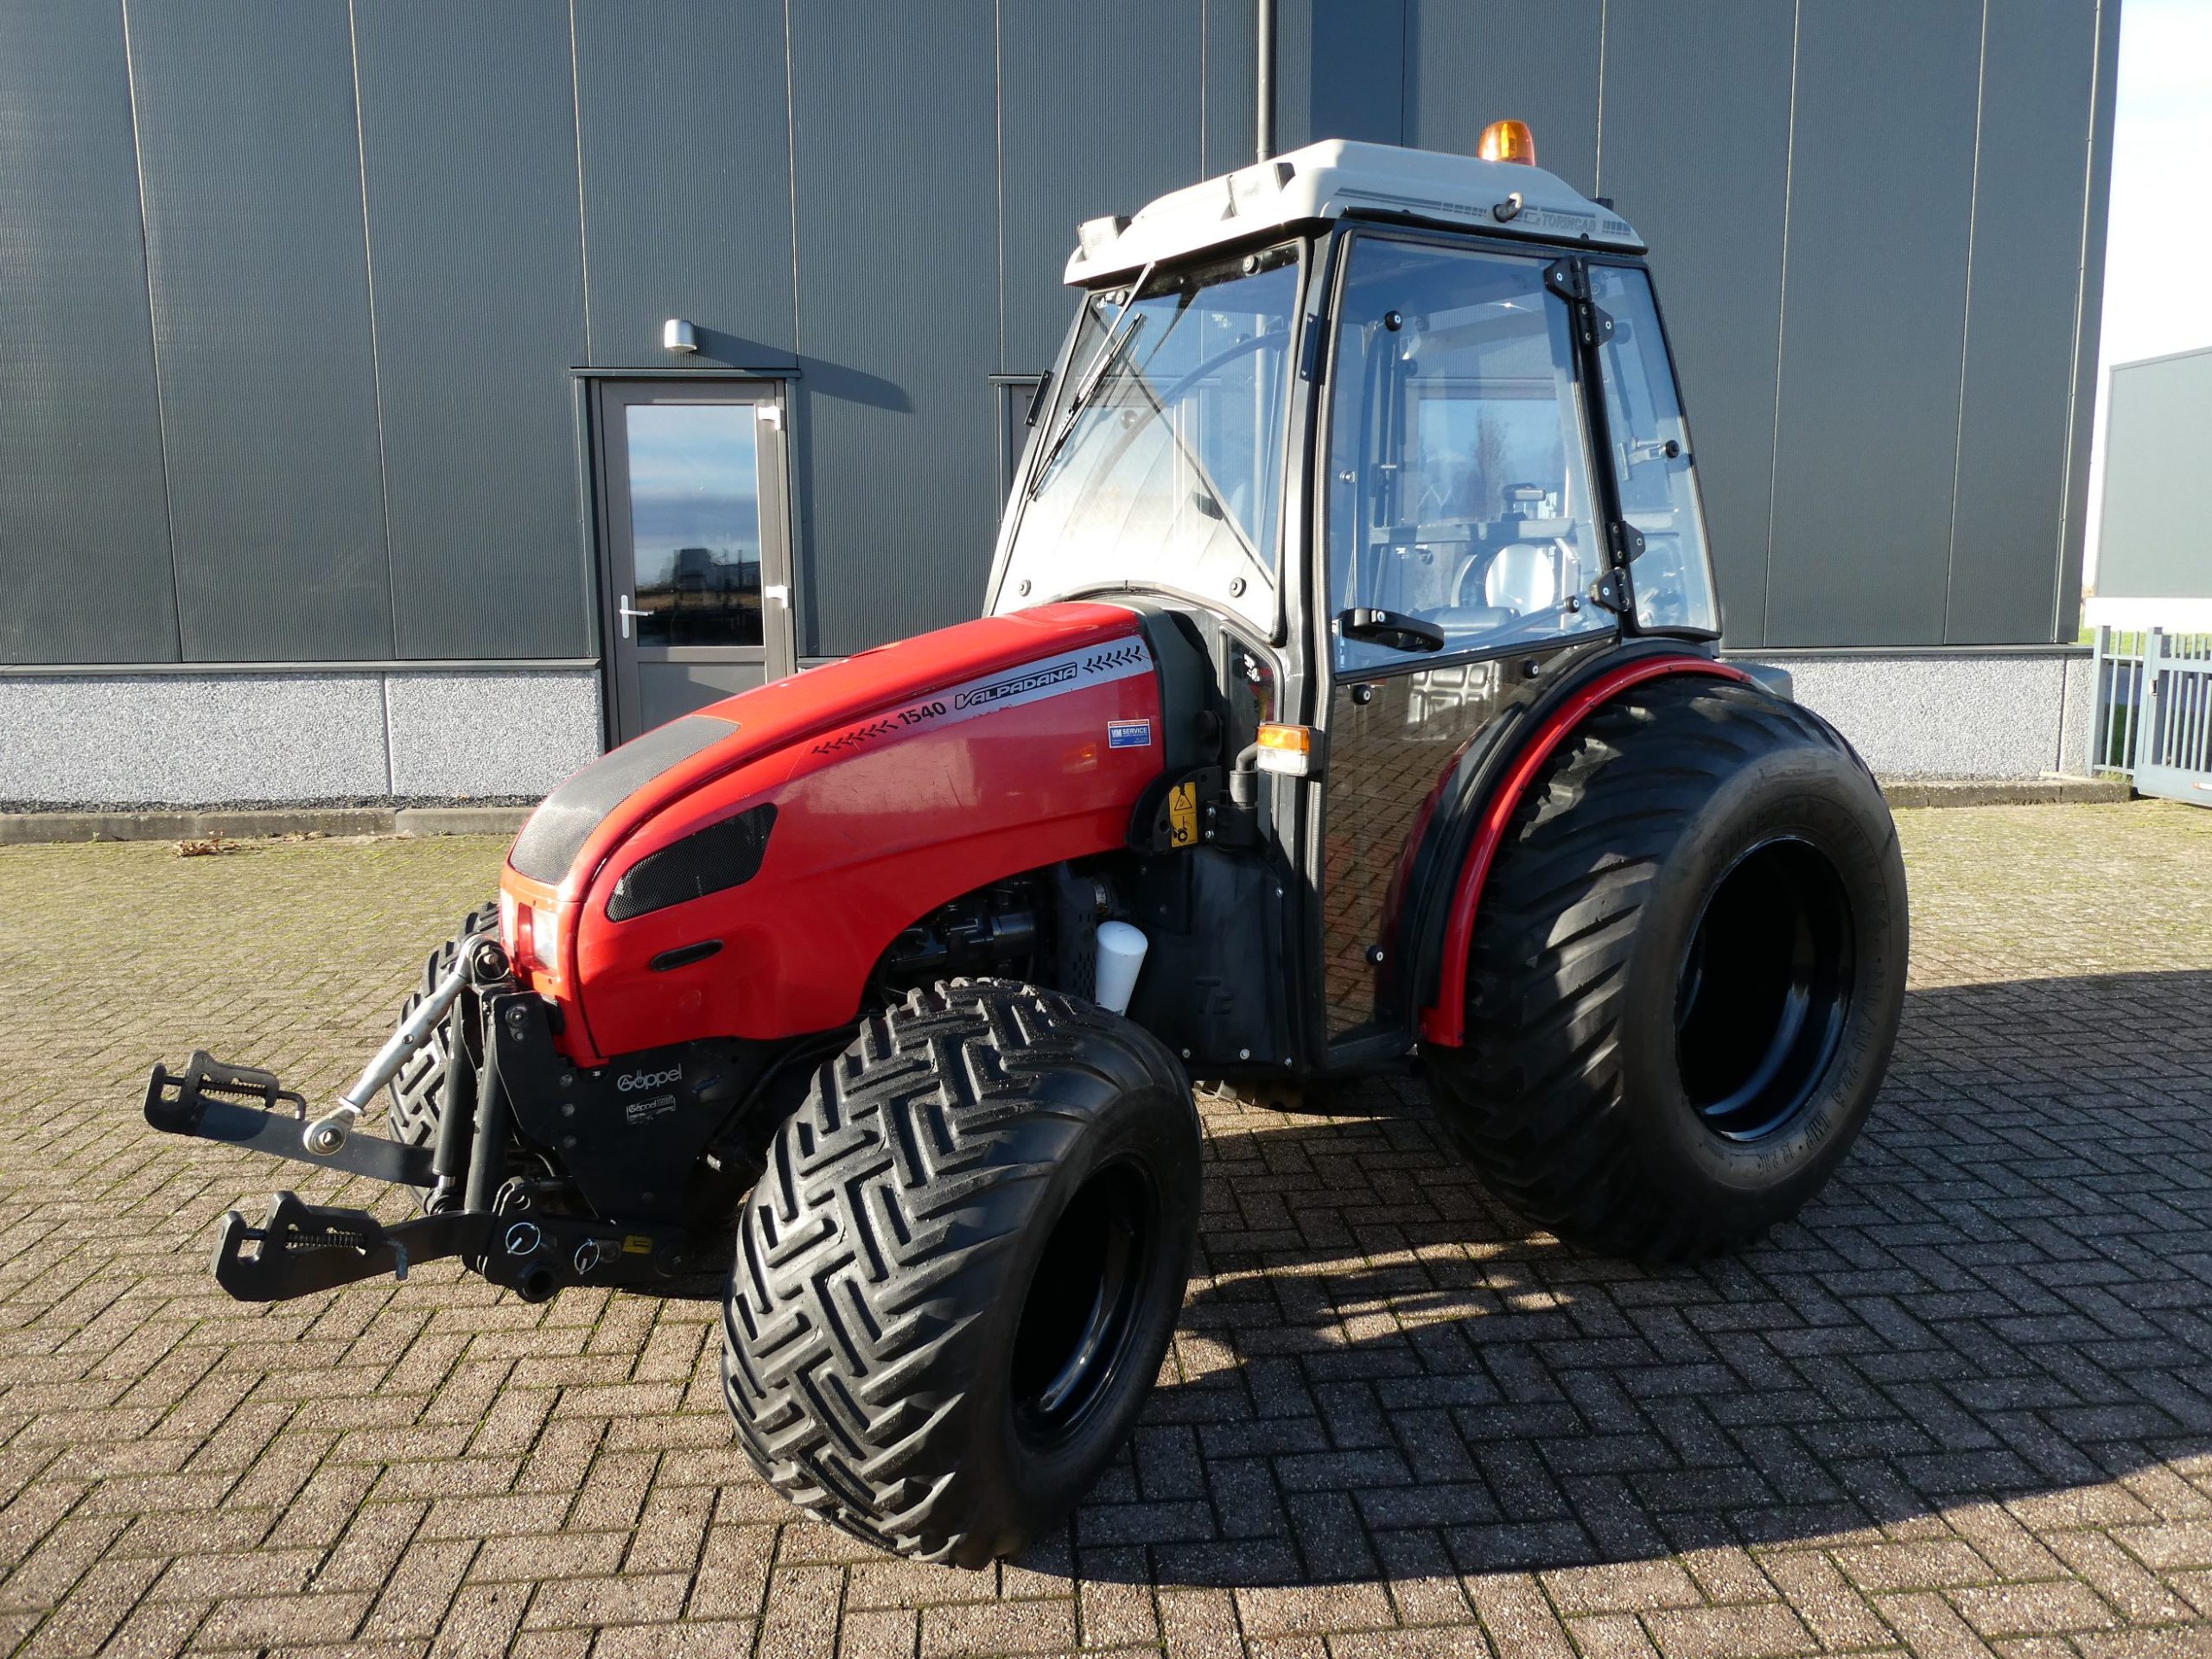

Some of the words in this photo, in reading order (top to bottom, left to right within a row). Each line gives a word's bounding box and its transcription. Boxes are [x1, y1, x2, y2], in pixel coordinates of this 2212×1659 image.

[897, 702, 947, 725] 1540
[955, 663, 1077, 709] VALPADANA
[1111, 728, 1122, 739] VM
[1122, 727, 1148, 735] SERVICE
